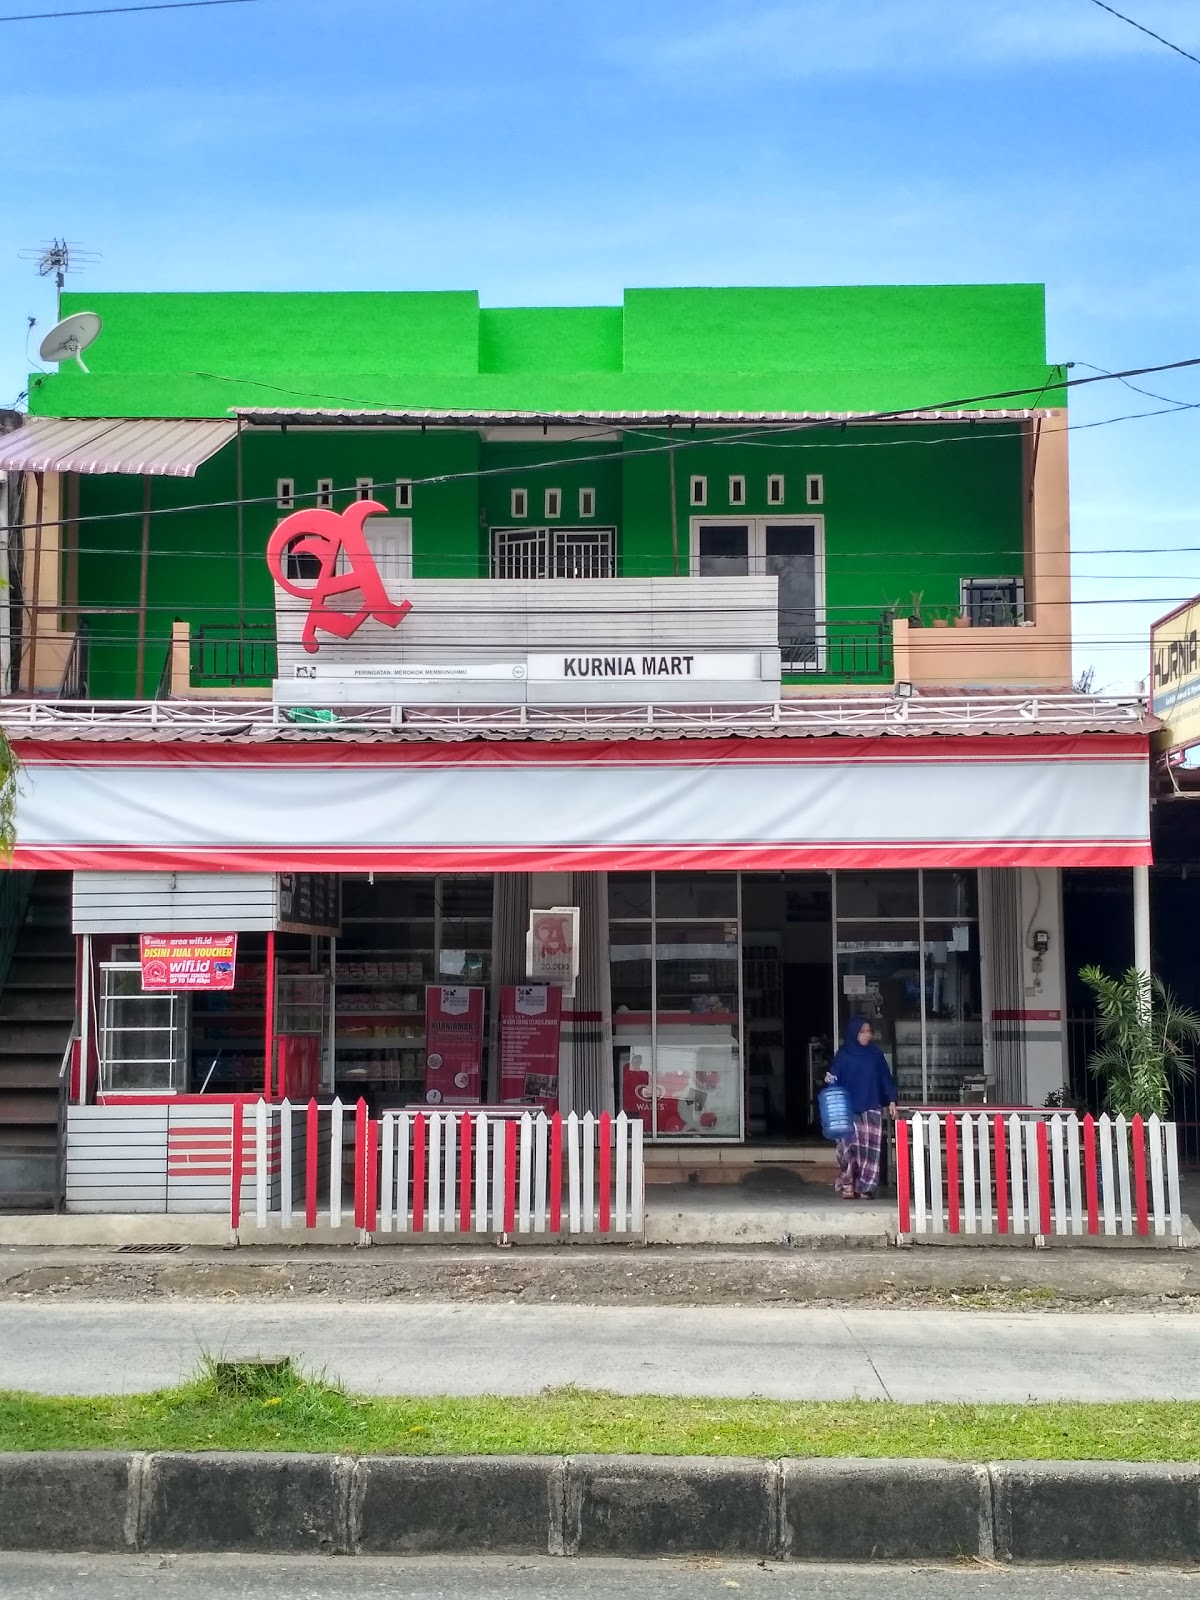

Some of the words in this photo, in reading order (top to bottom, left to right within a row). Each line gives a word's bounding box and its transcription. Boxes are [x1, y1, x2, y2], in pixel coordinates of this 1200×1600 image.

[1153, 629, 1197, 690] KURNIA
[564, 657, 637, 677] KURNIA
[642, 656, 694, 676] MART
[189, 936, 212, 944] wifi.id
[144, 948, 170, 958] DISINI
[171, 948, 192, 958] JUAL
[194, 947, 233, 957] VOUCHER
[169, 959, 211, 972] wifi.id
[540, 962, 570, 970] 20.000
